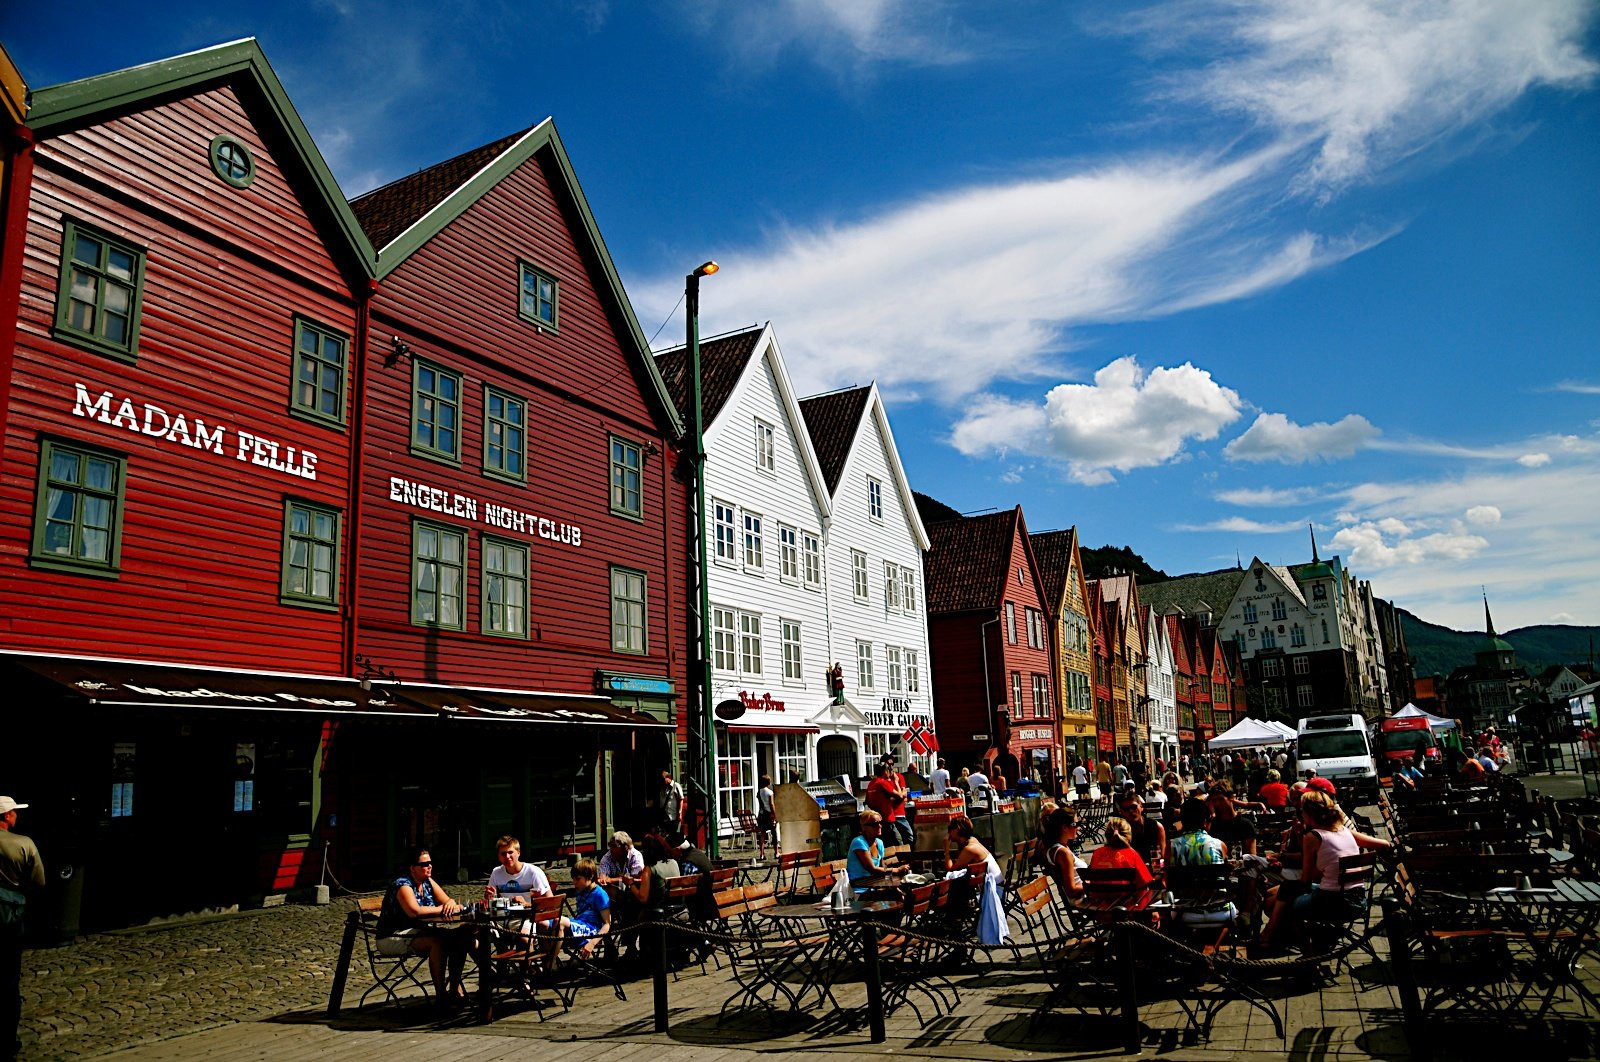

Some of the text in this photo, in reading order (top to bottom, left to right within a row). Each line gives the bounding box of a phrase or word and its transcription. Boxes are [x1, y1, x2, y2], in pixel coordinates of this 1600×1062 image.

[72, 382, 318, 481] MADAM FELLE
[389, 476, 582, 547] ENGELEN NIGHTCLUB
[864, 711, 895, 726] SILVER
